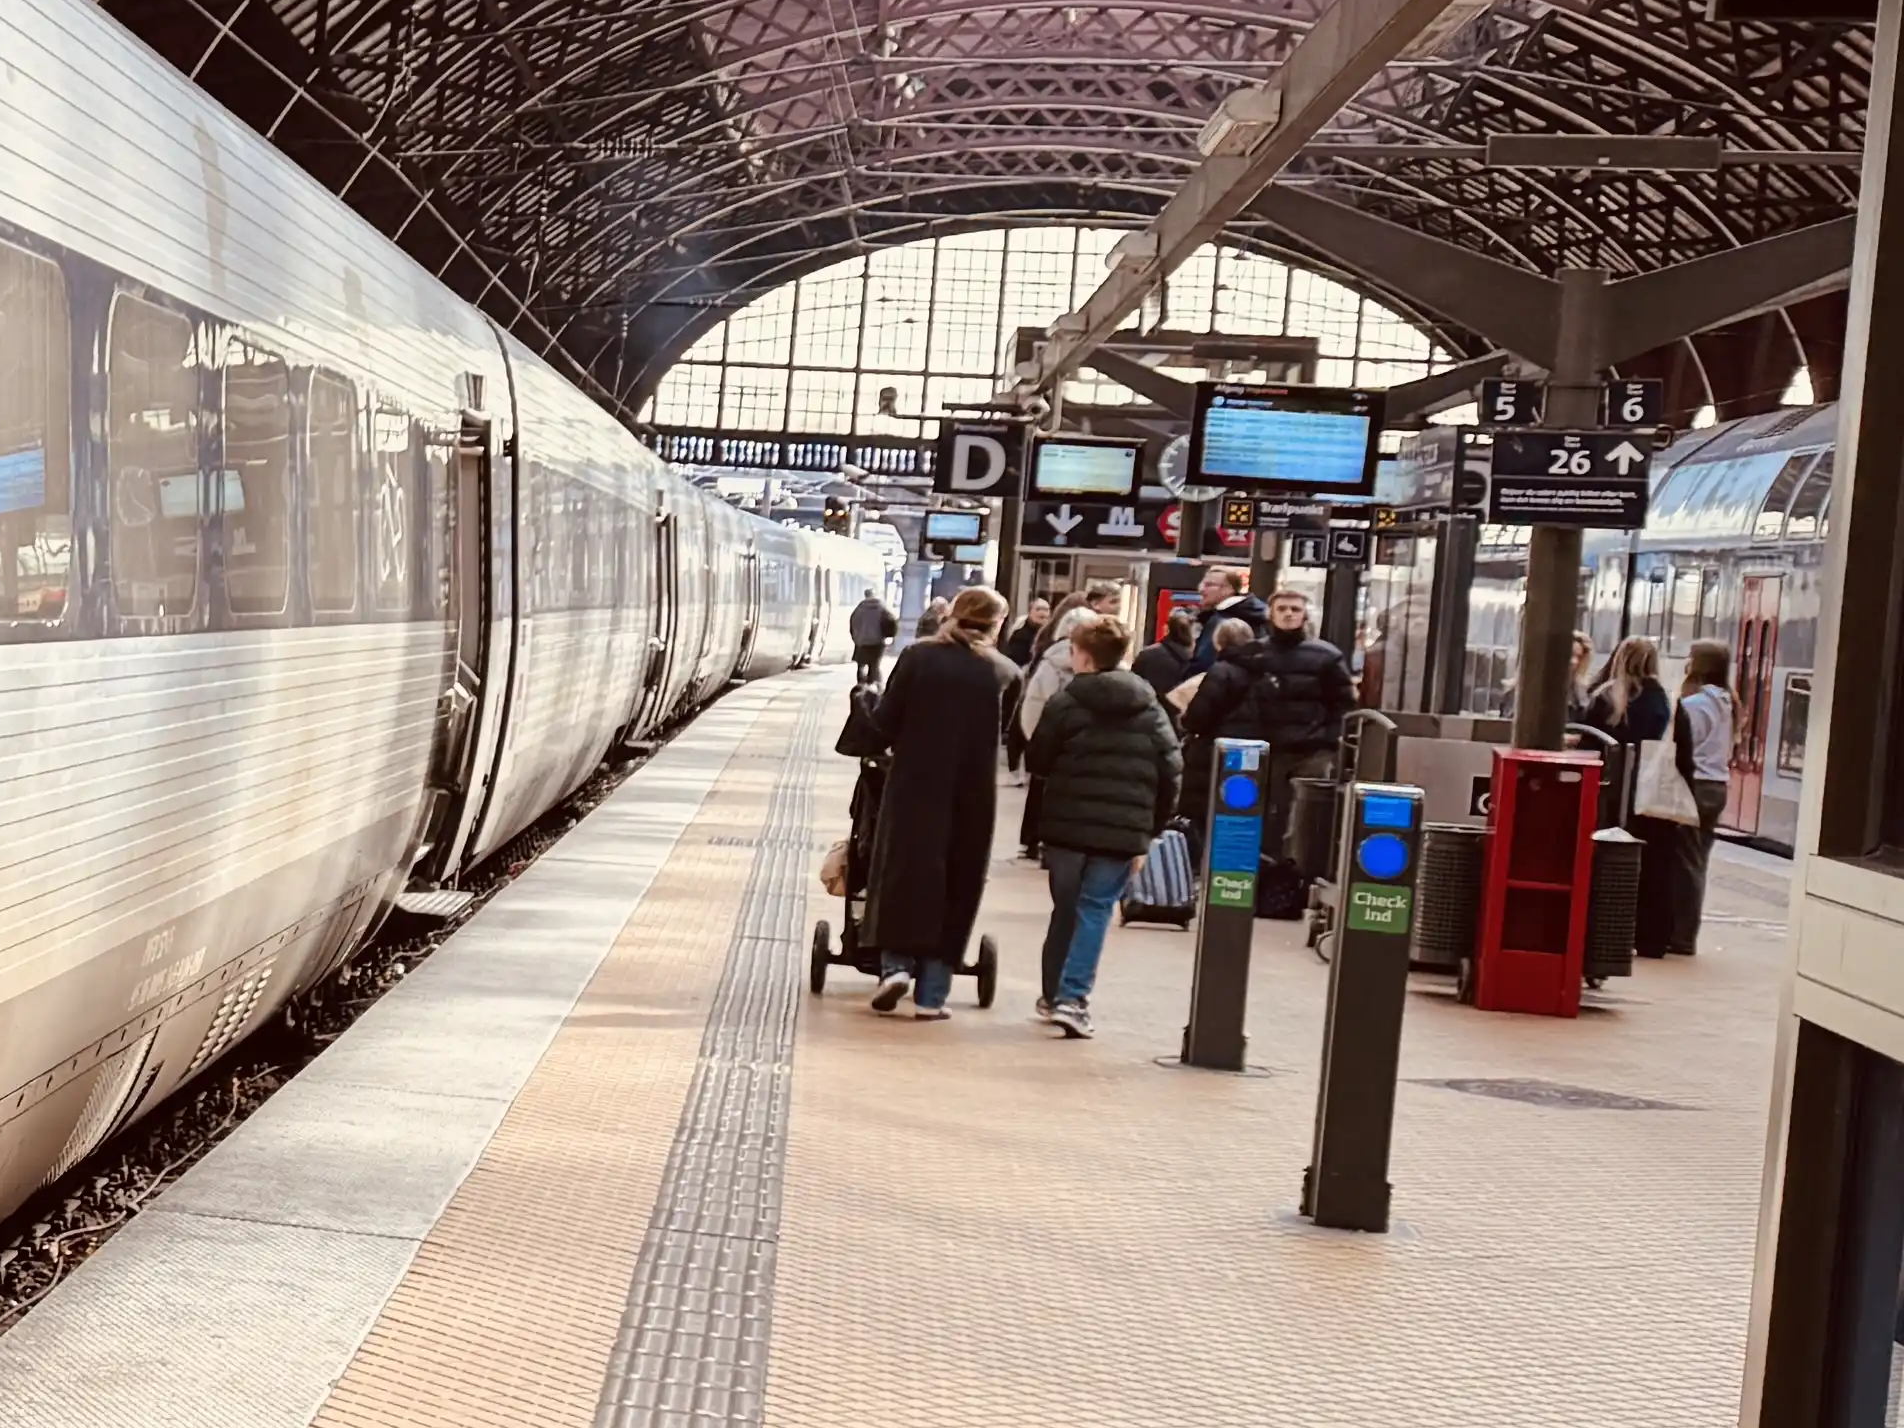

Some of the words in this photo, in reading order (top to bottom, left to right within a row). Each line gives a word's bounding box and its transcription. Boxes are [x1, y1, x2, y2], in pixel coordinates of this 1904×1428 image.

[1493, 396, 1516, 421] 5
[1622, 396, 1644, 422] 6
[950, 434, 1007, 491] D
[1547, 449, 1592, 475] 26
[1213, 875, 1253, 890] Check
[1354, 891, 1407, 908] Check
